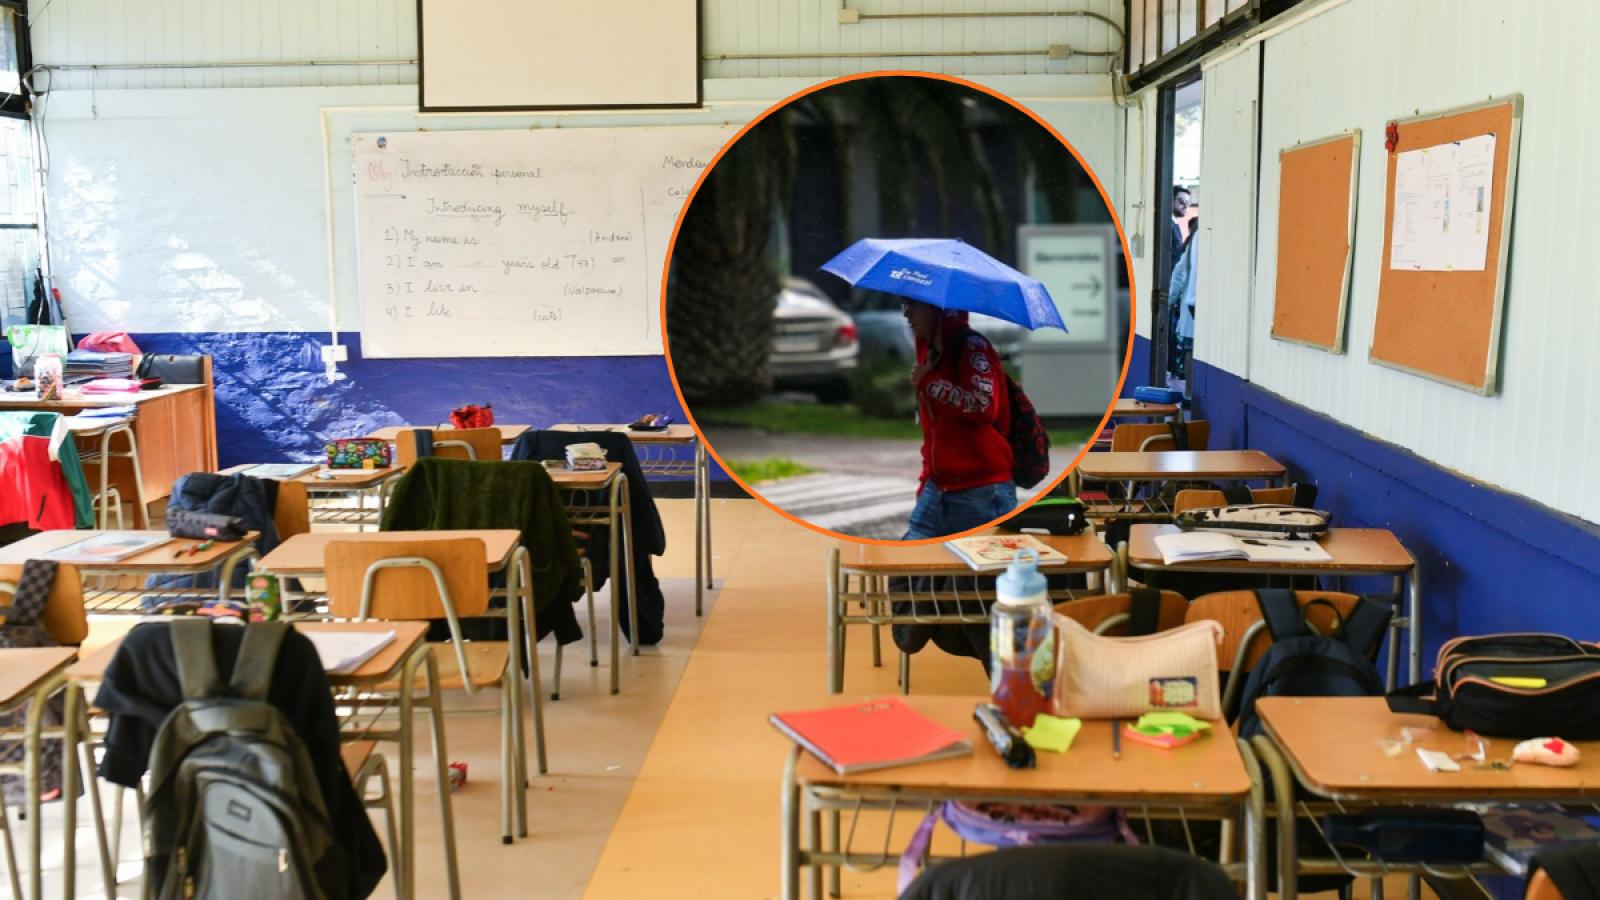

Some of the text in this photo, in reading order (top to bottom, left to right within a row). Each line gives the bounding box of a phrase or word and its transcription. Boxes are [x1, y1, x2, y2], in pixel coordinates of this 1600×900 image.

[662, 155, 706, 169] Monda
[491, 167, 542, 186] personal
[426, 198, 568, 225] Introducing myself
